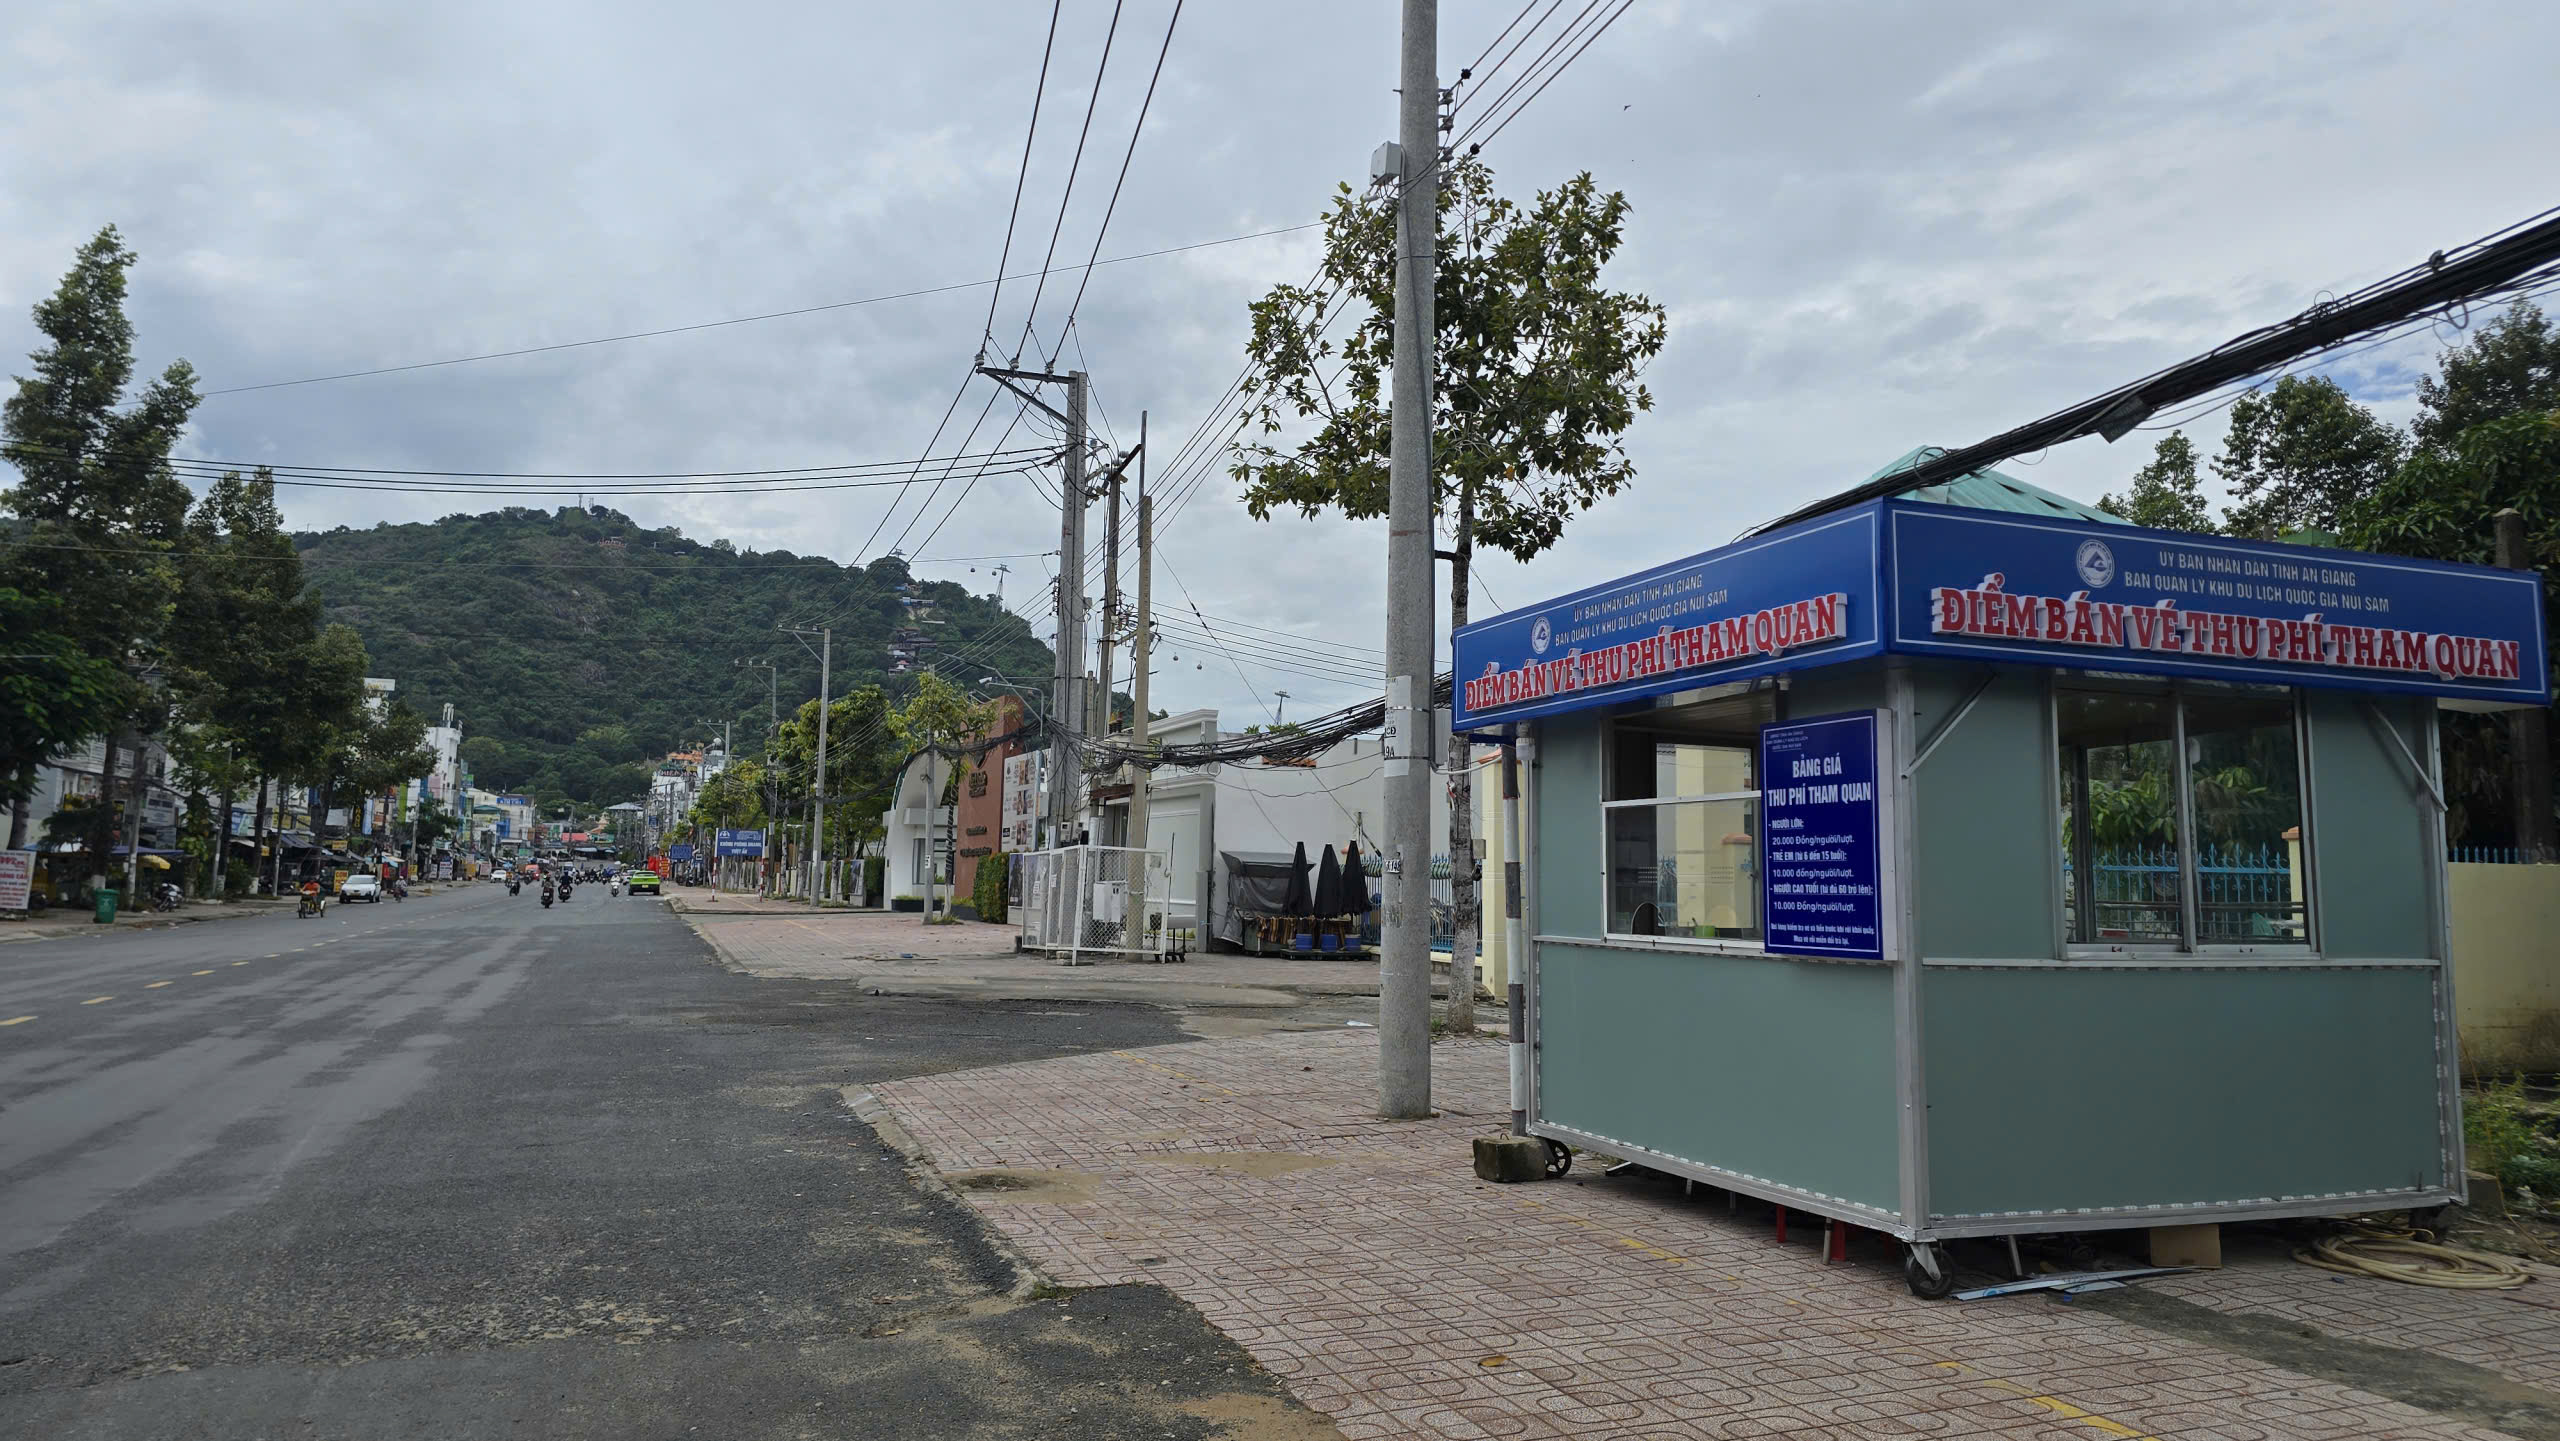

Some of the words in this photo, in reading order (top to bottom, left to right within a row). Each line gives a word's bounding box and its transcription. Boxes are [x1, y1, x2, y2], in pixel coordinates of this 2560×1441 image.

[2178, 553, 2204, 570] BAN
[2302, 567, 2319, 583] AN
[2321, 569, 2356, 587] GIANG
[1585, 603, 1600, 620] BAN
[1662, 582, 1674, 598] AN
[1676, 574, 1703, 594] GIANG
[2124, 571, 2151, 589] BAN
[2209, 580, 2233, 597] KHU
[2236, 583, 2253, 599] DU
[2319, 592, 2339, 608] GIA
[2364, 596, 2390, 613] SAM
[1555, 631, 1569, 647] BAN
[1601, 619, 1617, 634] KHU
[1618, 615, 1628, 630] DU
[1673, 600, 1687, 616] GIA
[1707, 589, 1728, 607] SAM
[1934, 572, 2038, 640] ĐIỂM
[2045, 590, 2126, 648] BÁN
[2129, 599, 2183, 652] VÉ
[2186, 612, 2261, 660] THU
[2265, 613, 2326, 665] PHÍ
[2327, 626, 2431, 673] THAM
[2433, 634, 2521, 681] QUAN
[1464, 661, 1506, 712] ĐIỂM
[1508, 658, 1548, 703] BÁN
[1550, 648, 1581, 694] VÉ
[1579, 645, 1624, 688] THU
[1626, 625, 1668, 679] PHÍ
[1670, 615, 1750, 669] THAM
[1753, 593, 1840, 657] QUAN
[1792, 754, 1821, 778] BẢNG
[1823, 752, 1843, 775] GIÁ
[1767, 789, 1787, 807] THU
[1789, 783, 1806, 806] PHÍ
[1808, 784, 1839, 804] THAM
[1841, 782, 1872, 804] QUAN
[1772, 836, 1795, 846] 20.000
[1784, 851, 1794, 860] EM
[1804, 851, 1808, 860] 6
[1822, 851, 1829, 860] 15
[1773, 868, 1794, 878] 10.000
[1792, 884, 1804, 893] CAO
[1838, 884, 1847, 893] 60
[1774, 901, 1795, 911] 10.000
